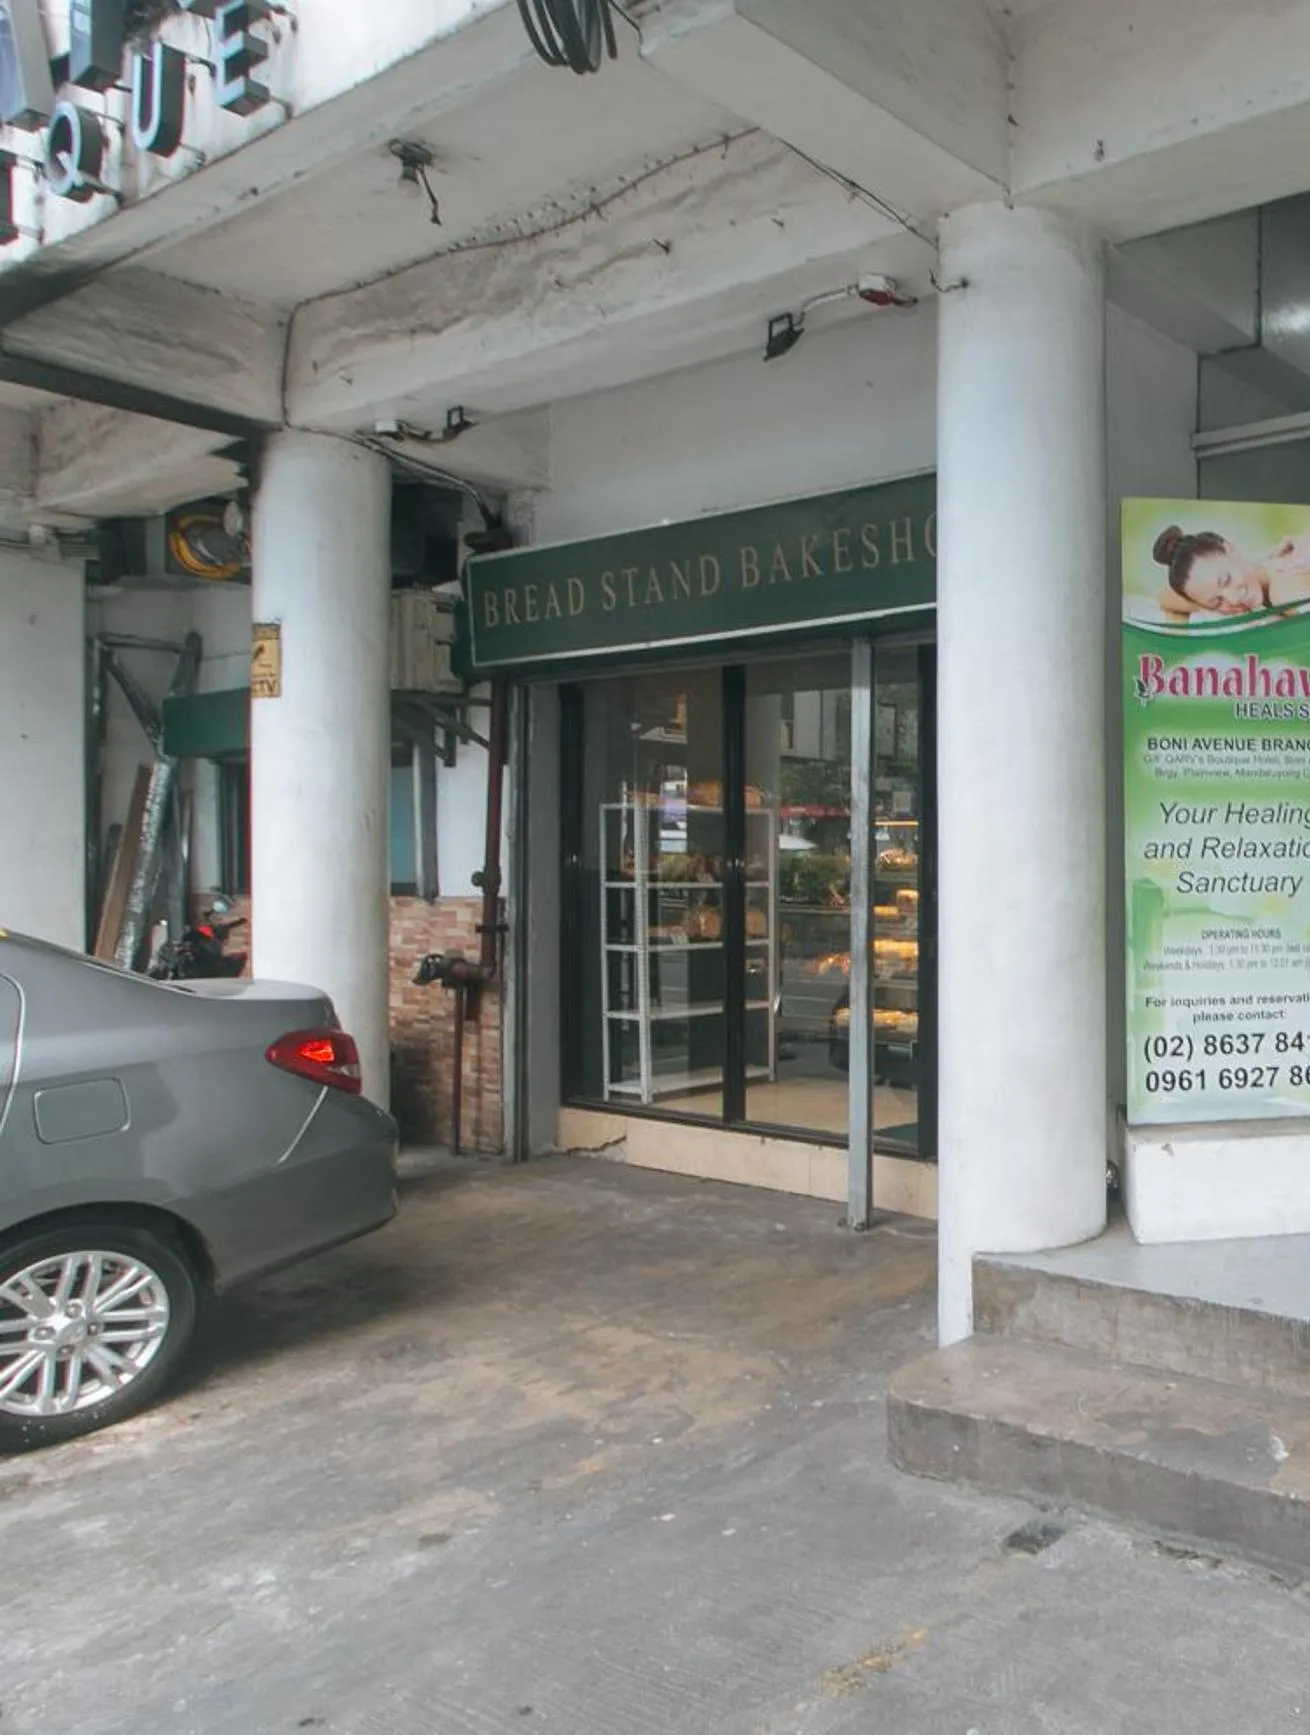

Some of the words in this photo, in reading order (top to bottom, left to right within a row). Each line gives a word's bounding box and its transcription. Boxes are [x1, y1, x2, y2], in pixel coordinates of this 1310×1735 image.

[483, 577, 586, 628] BREAD
[601, 554, 722, 611] STAND
[1235, 702, 1294, 719] HEALS
[1147, 737, 1187, 751] BONI
[1192, 737, 1257, 751] AVENUE
[1159, 801, 1219, 826] Your
[1143, 838, 1192, 860] and
[1176, 871, 1304, 898] Sanctuary
[1145, 996, 1167, 1008] For
[1171, 996, 1226, 1010] inquiries
[1229, 995, 1254, 1005] and
[1192, 1011, 1234, 1025] please
[1143, 1035, 1194, 1063] (02)
[1204, 1032, 1266, 1056] 8637
[1145, 1069, 1206, 1093] 0961
[1219, 1066, 1280, 1089] 6927
